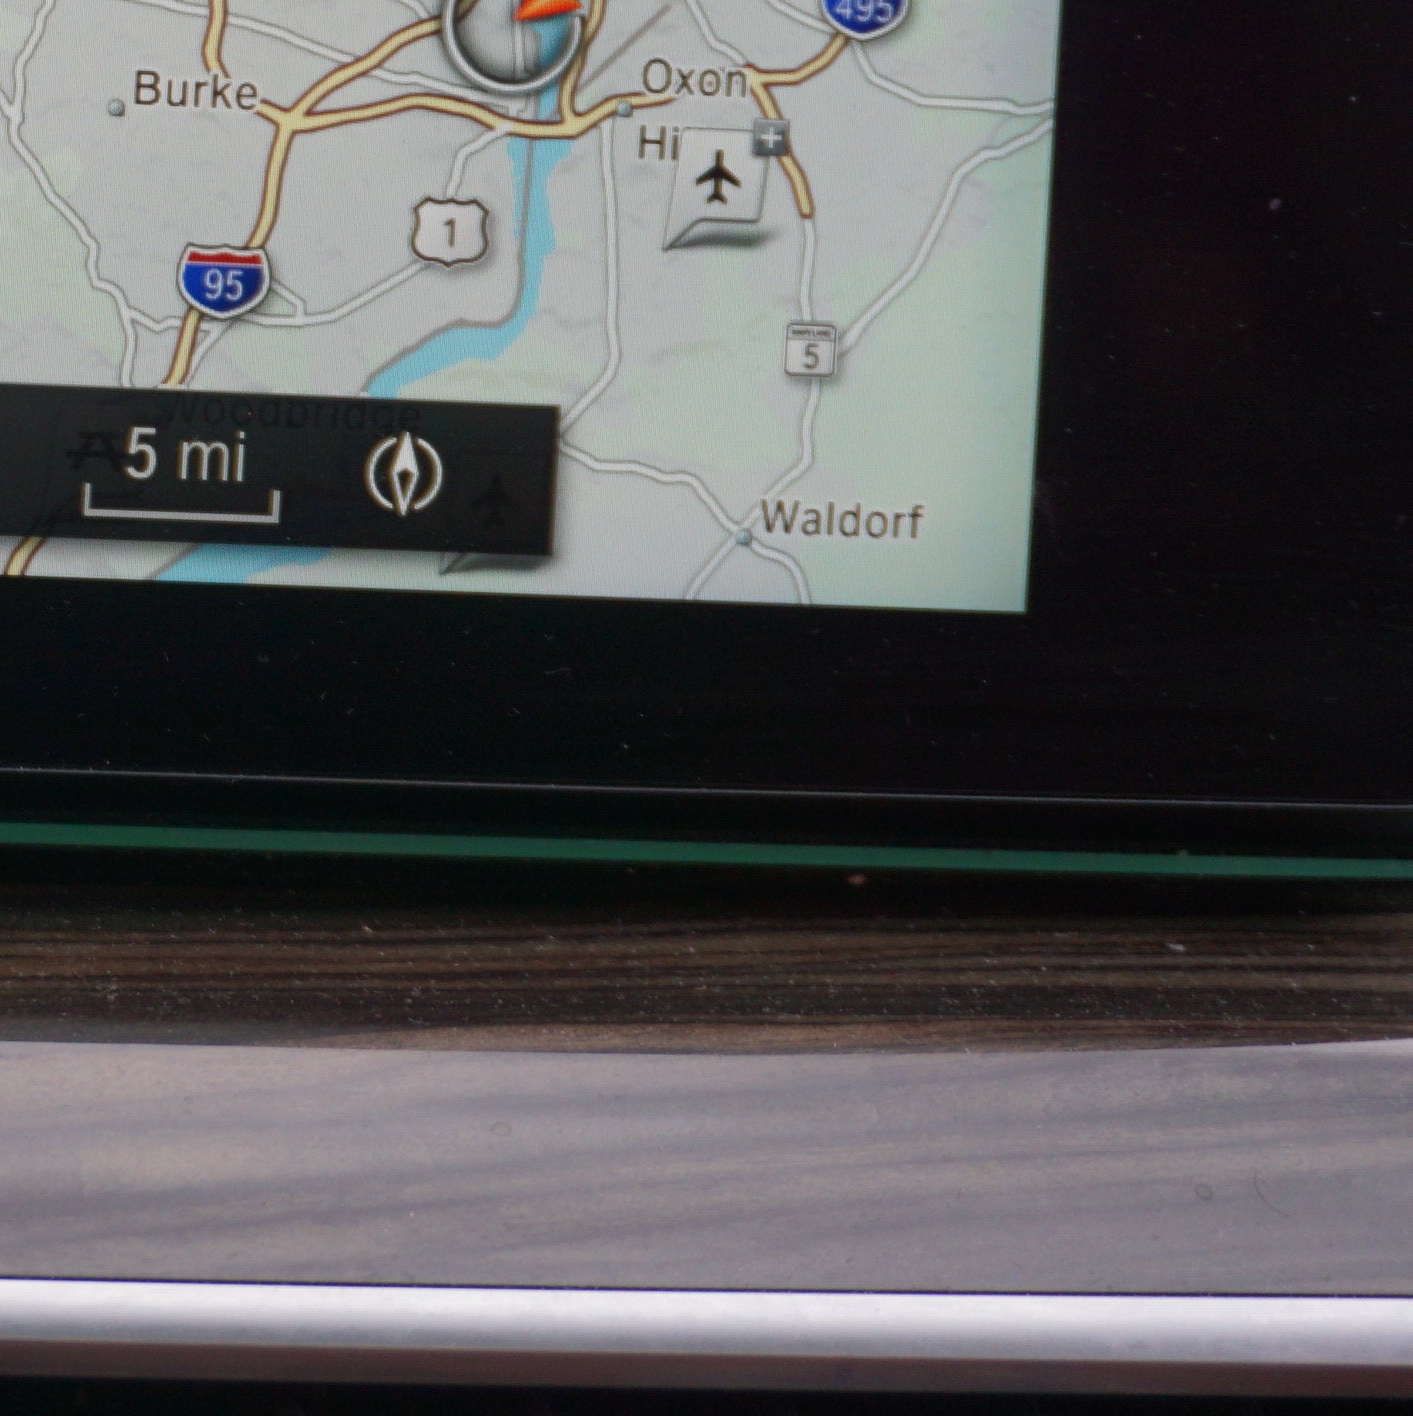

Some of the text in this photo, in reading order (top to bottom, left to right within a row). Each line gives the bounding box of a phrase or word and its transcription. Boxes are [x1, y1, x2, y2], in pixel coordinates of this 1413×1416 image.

[134, 71, 259, 111] Burke
[642, 58, 748, 98] Oxon
[443, 218, 457, 248] 1
[205, 268, 244, 303] 95
[804, 343, 820, 369] 5
[125, 427, 246, 482] 5 mi
[761, 499, 926, 539] Waldorf
